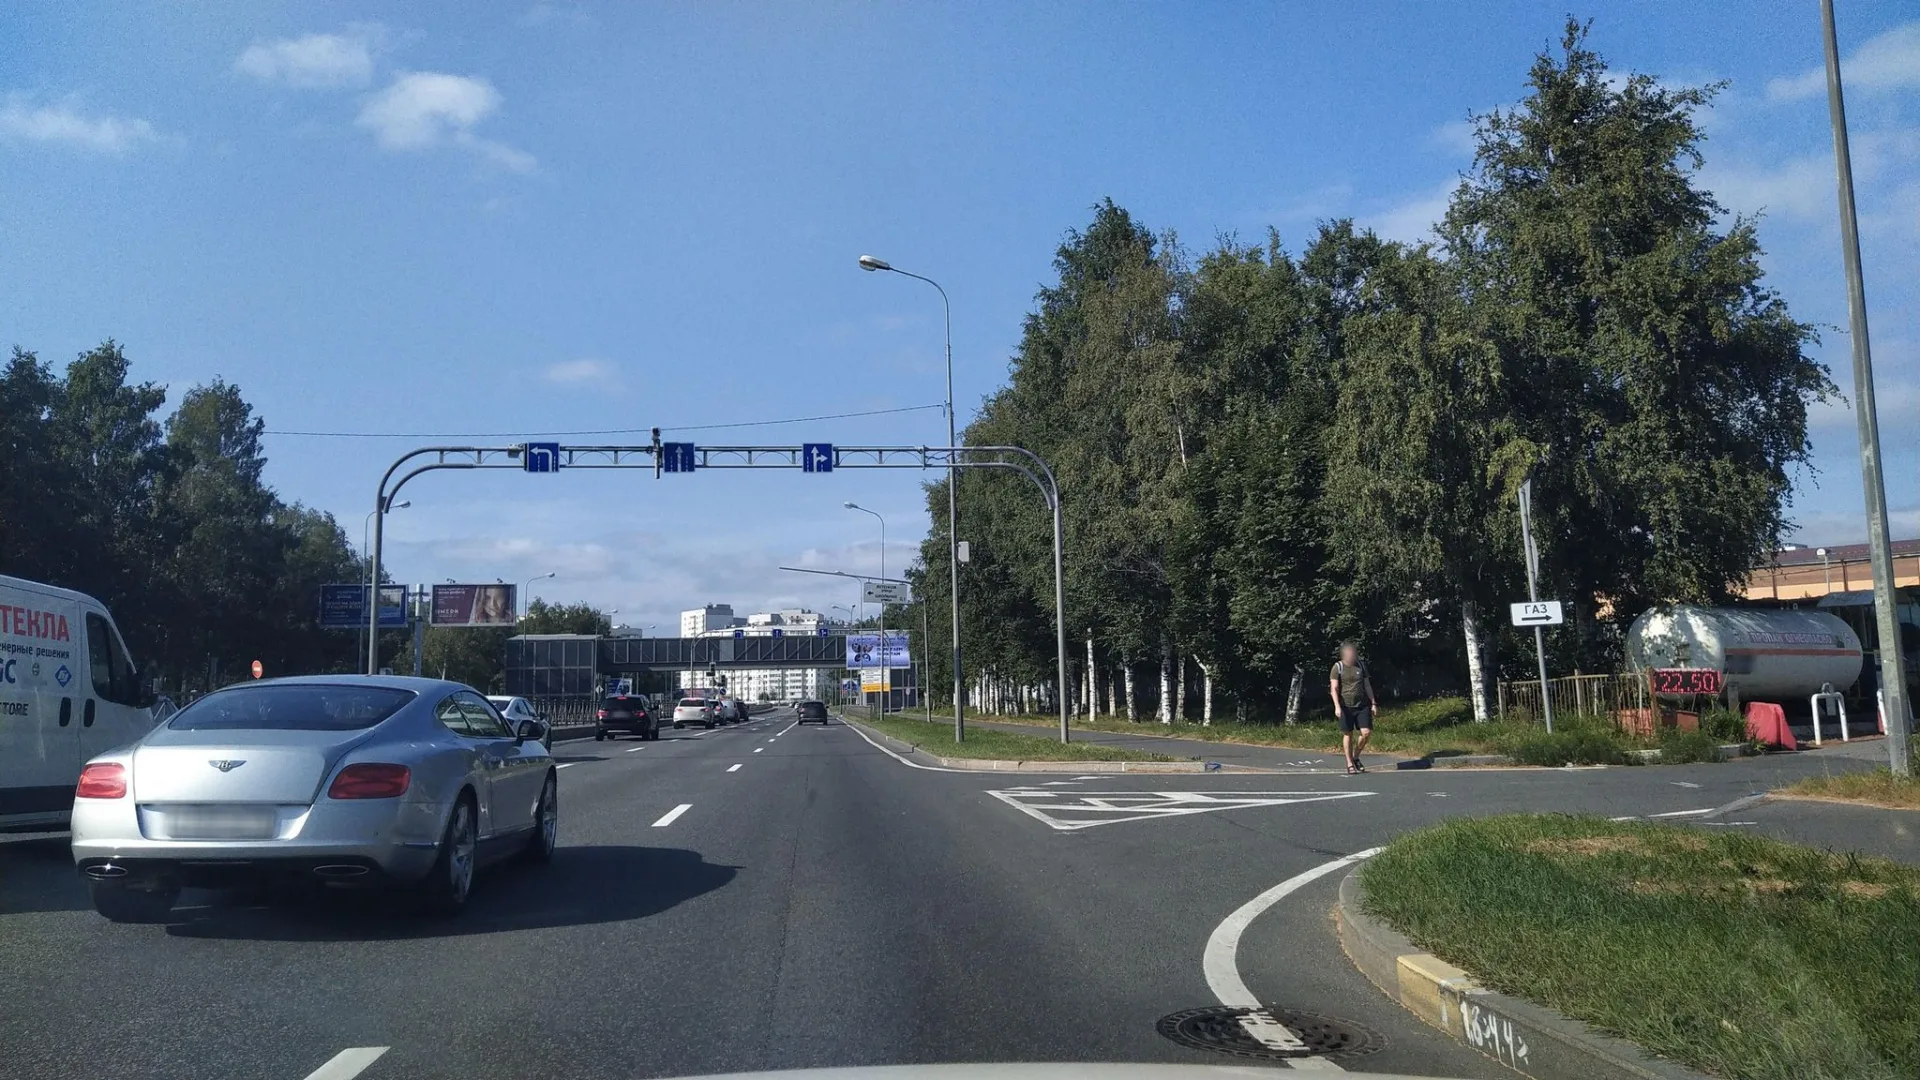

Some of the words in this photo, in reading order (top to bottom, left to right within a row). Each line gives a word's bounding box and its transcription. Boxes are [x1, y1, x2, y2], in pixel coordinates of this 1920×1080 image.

[1525, 604, 1547, 614] ГАЗ
[1751, 632, 1783, 644] ПРОПАН
[1785, 633, 1832, 645] ОГНЕОПАСНО
[36, 647, 70, 660] решения
[1659, 672, 1714, 692] 22.50
[0, 702, 29, 716] TORE
